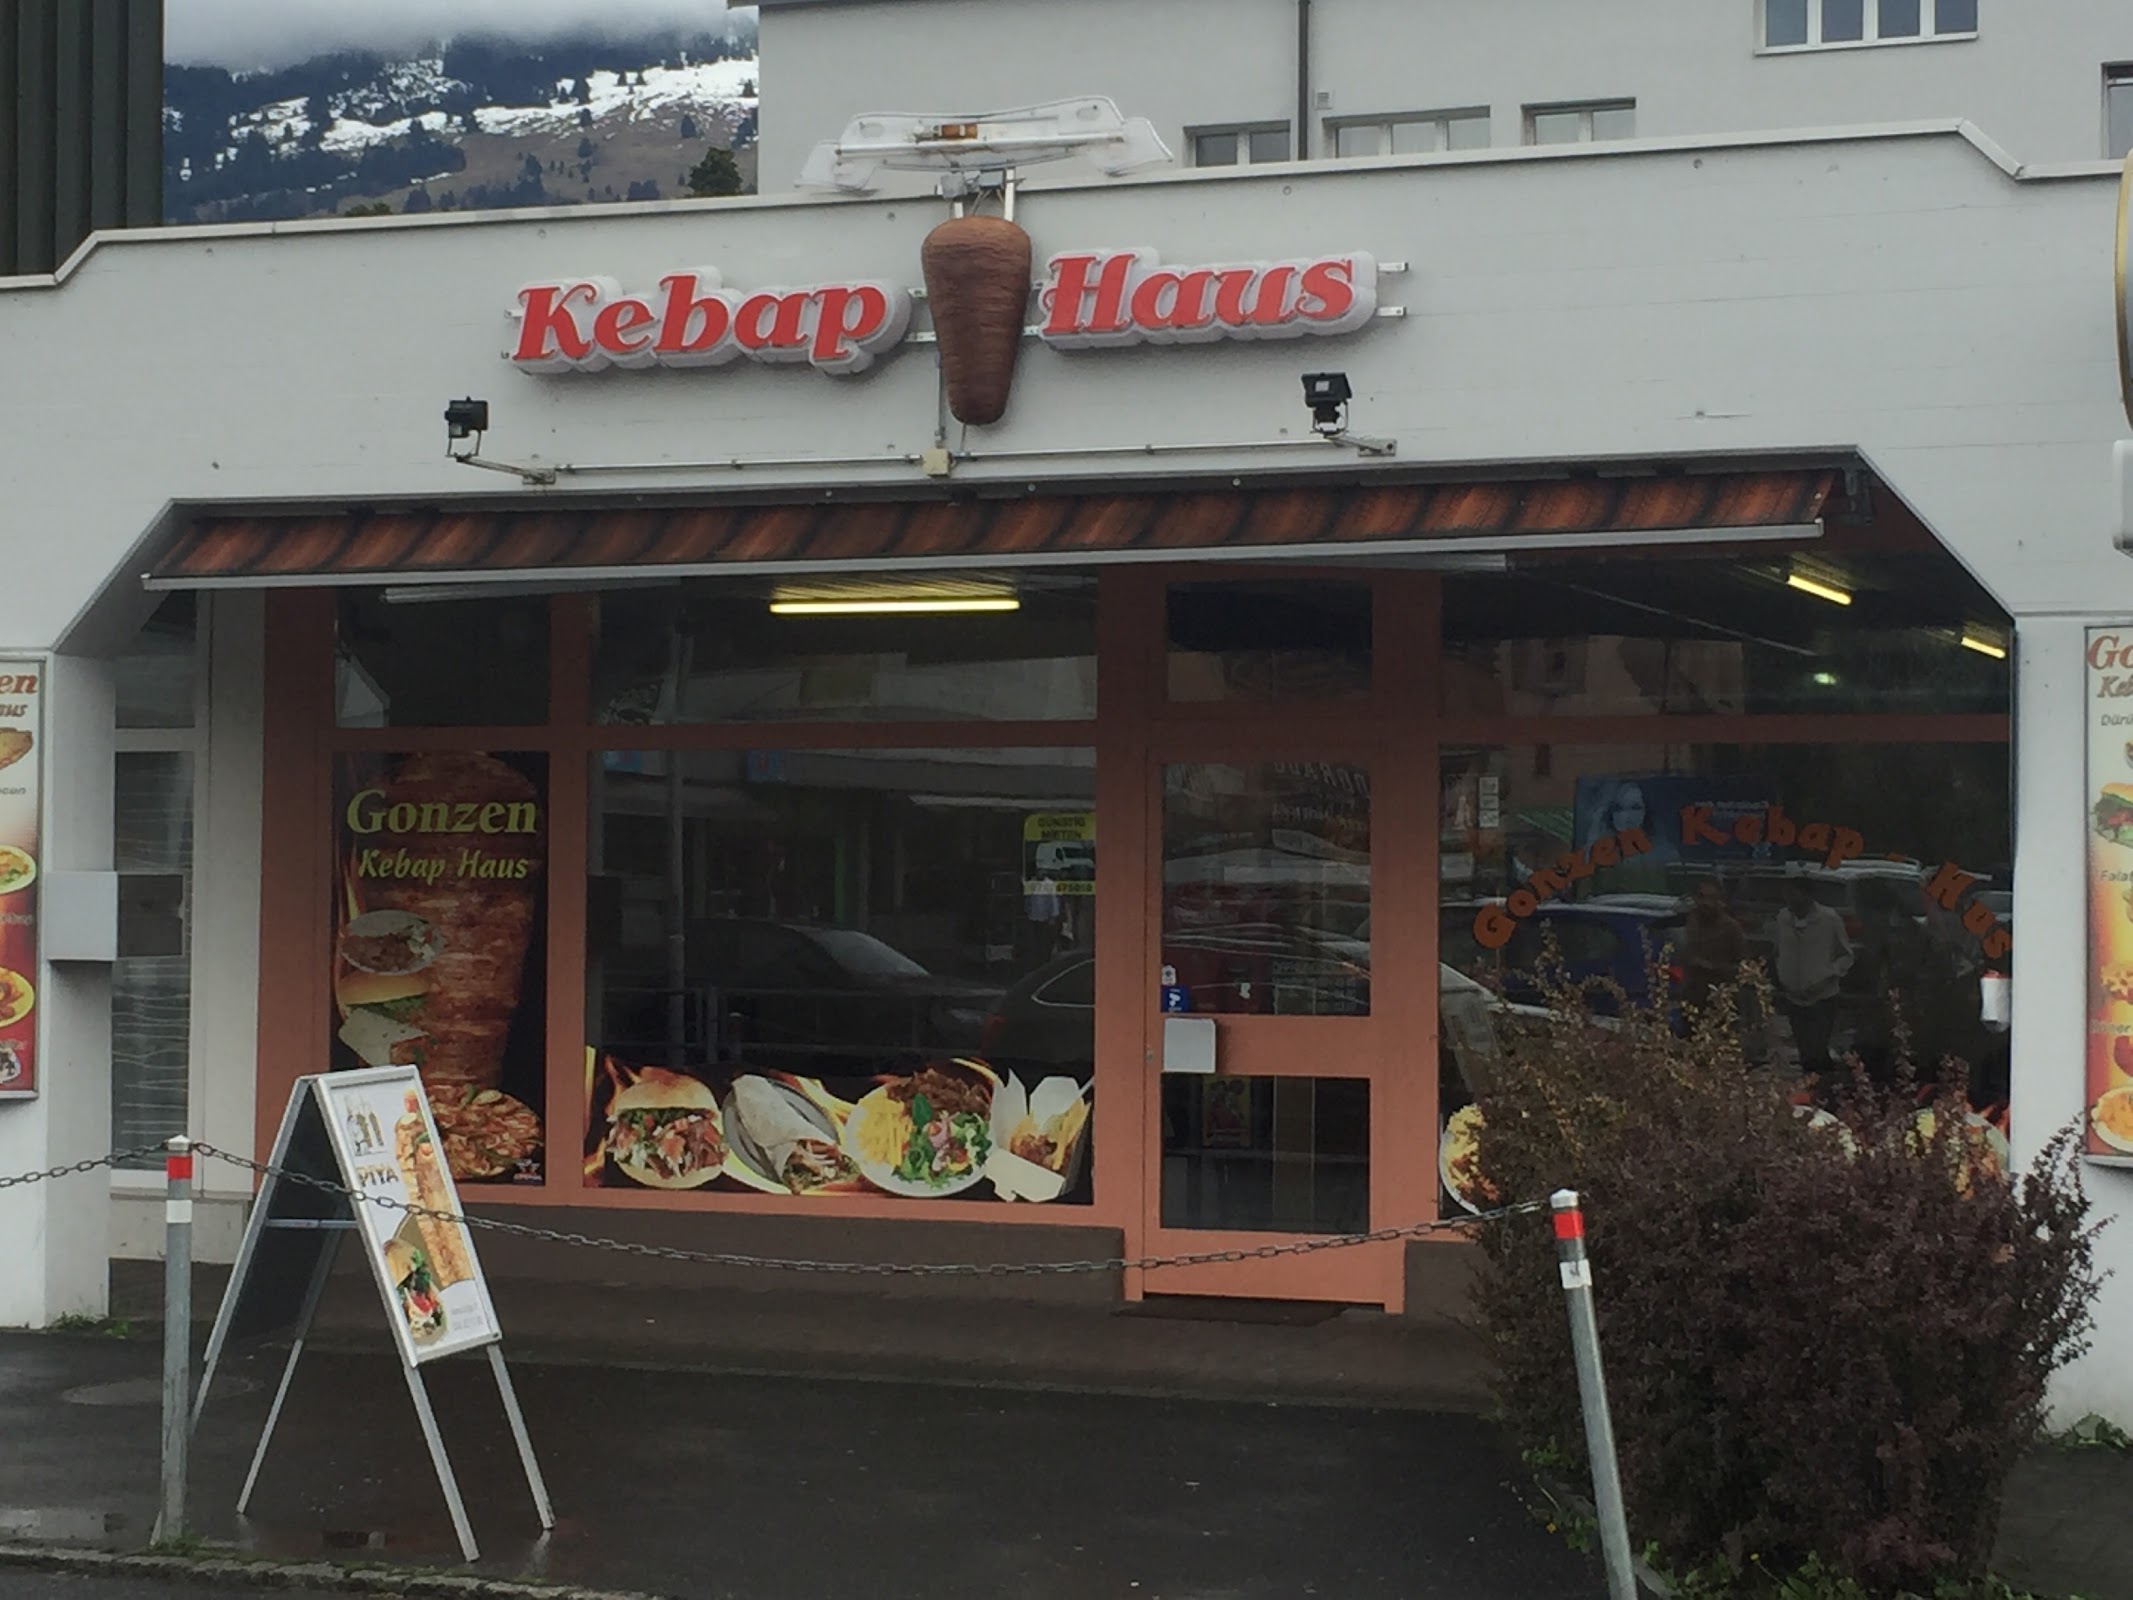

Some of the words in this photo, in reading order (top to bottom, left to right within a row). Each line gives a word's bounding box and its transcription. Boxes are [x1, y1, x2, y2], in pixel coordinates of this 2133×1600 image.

[512, 273, 888, 362] Kebap
[1041, 253, 1353, 336] Haus
[347, 788, 537, 834] Gonzen
[358, 847, 446, 886] Kebap
[456, 848, 529, 879] Haus
[1473, 827, 1655, 949] Gonzen
